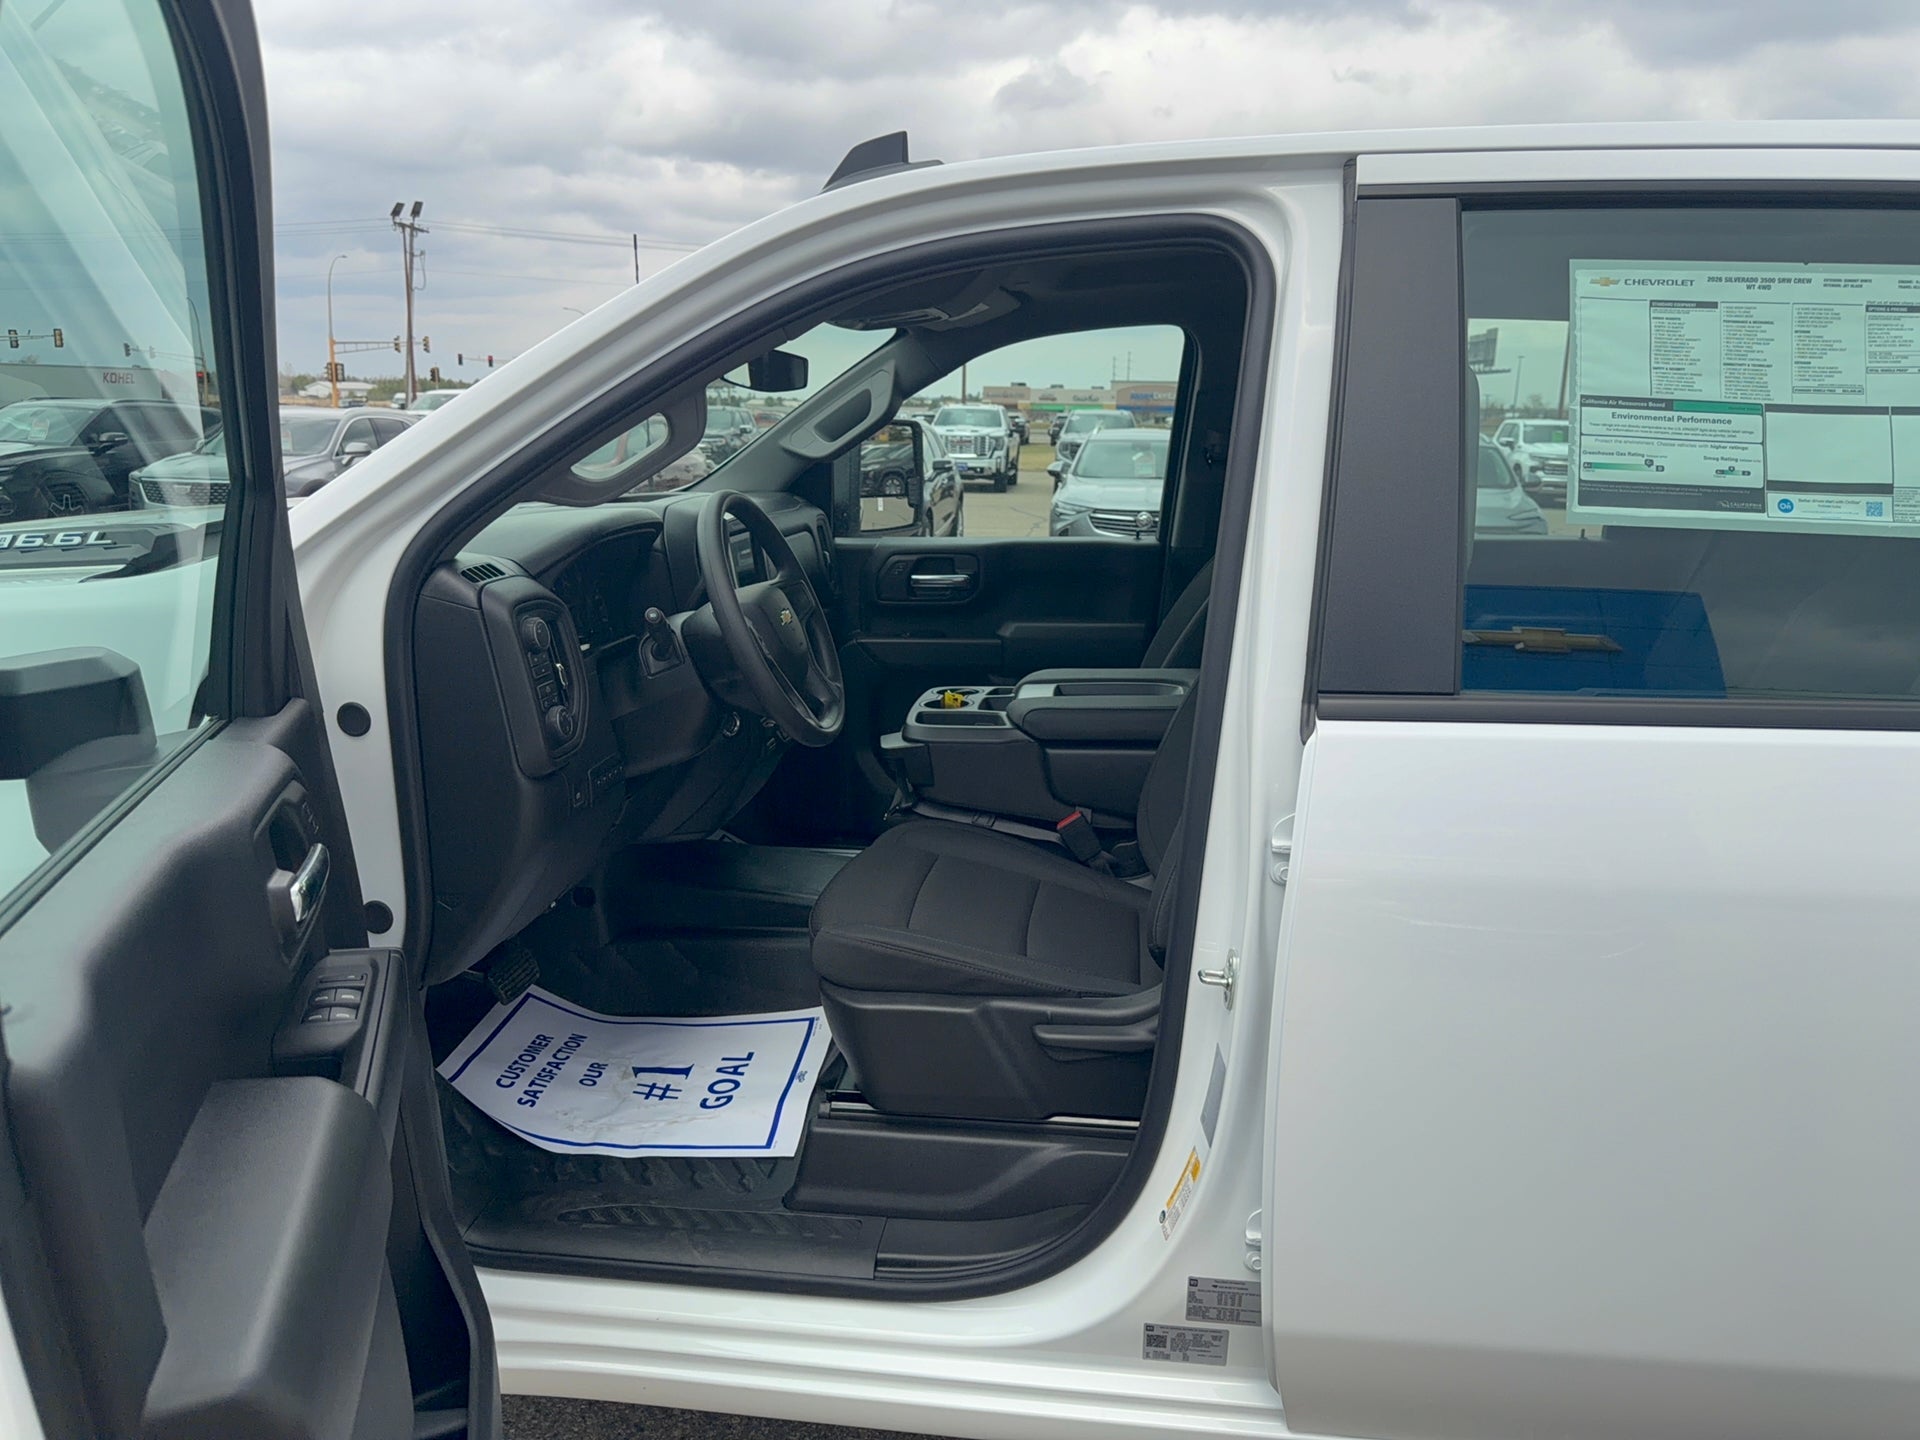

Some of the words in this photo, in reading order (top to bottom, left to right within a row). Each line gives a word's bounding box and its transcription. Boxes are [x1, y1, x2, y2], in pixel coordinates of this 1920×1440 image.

[1624, 278, 1695, 286] CHEVROLET
[1611, 412, 1674, 422] Environmental
[1677, 415, 1732, 425] Performance
[13, 530, 112, 547] 6.6L
[495, 1033, 555, 1089] CUSTOMER
[517, 1033, 589, 1108] SATISFACTION
[578, 1062, 609, 1087] OUR
[631, 1063, 695, 1101] #1
[699, 1051, 755, 1110] GOAL
